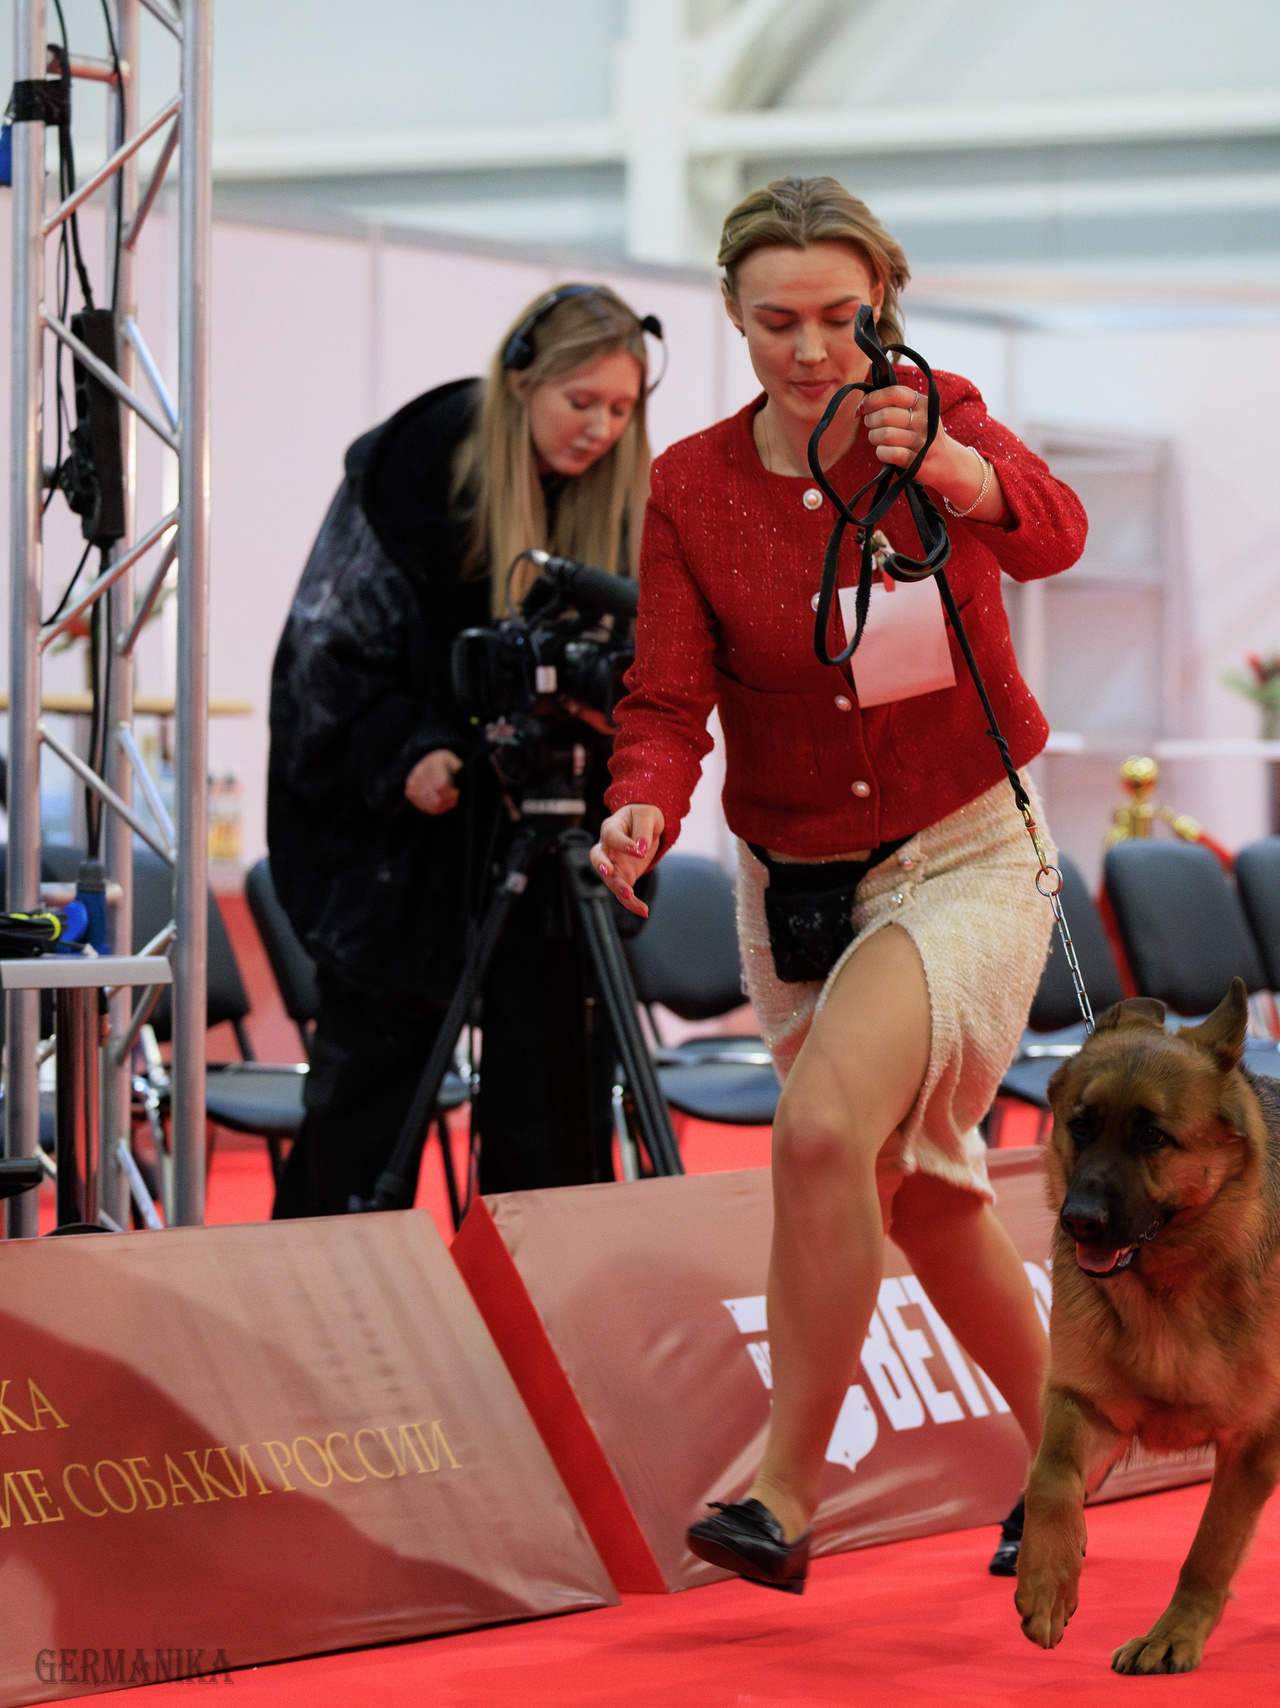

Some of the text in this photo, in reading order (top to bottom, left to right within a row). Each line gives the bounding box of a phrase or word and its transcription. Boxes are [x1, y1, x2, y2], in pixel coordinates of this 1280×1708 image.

[0, 1377, 70, 1435] КА
[62, 1444, 272, 1517] СОБАКИ
[261, 1419, 463, 1488] РОССИИ
